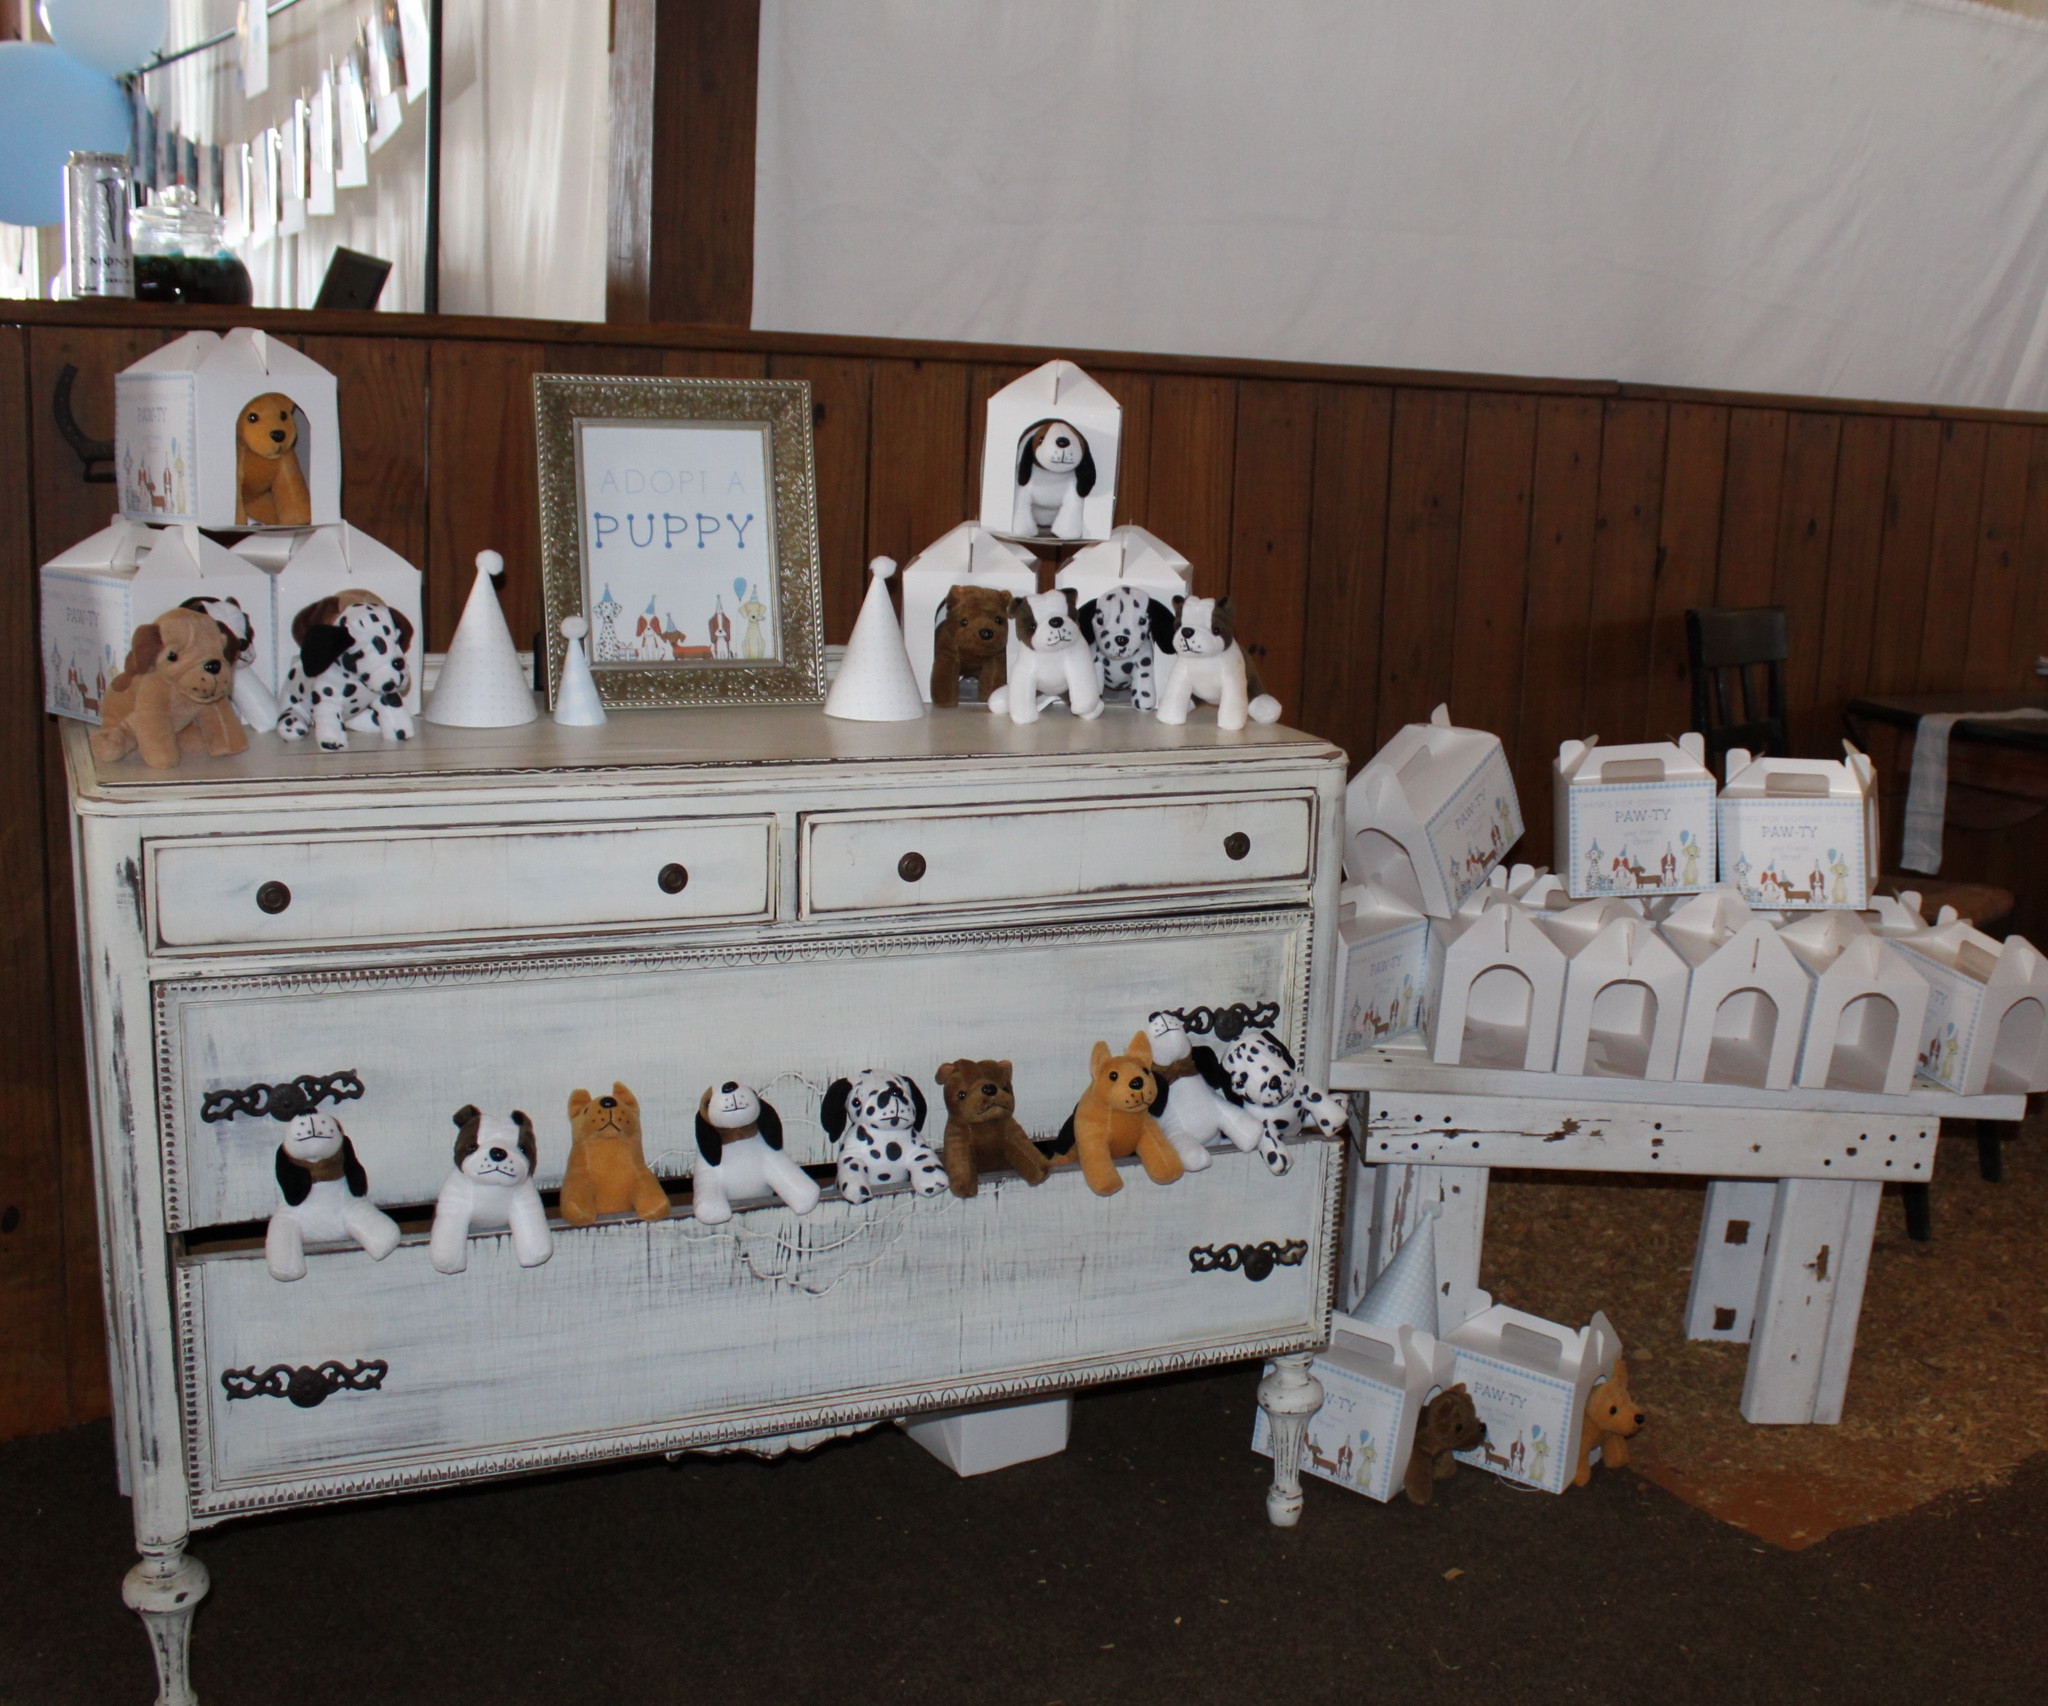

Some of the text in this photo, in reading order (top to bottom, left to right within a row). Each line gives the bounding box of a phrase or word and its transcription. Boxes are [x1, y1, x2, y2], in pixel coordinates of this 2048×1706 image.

[600, 468, 746, 495] ADOPT A
[593, 512, 754, 549] PUPPY
[1614, 808, 1672, 823] PAW-TY
[1761, 825, 1818, 839] PAW-TY
[1473, 1381, 1528, 1409] PAW-TY
